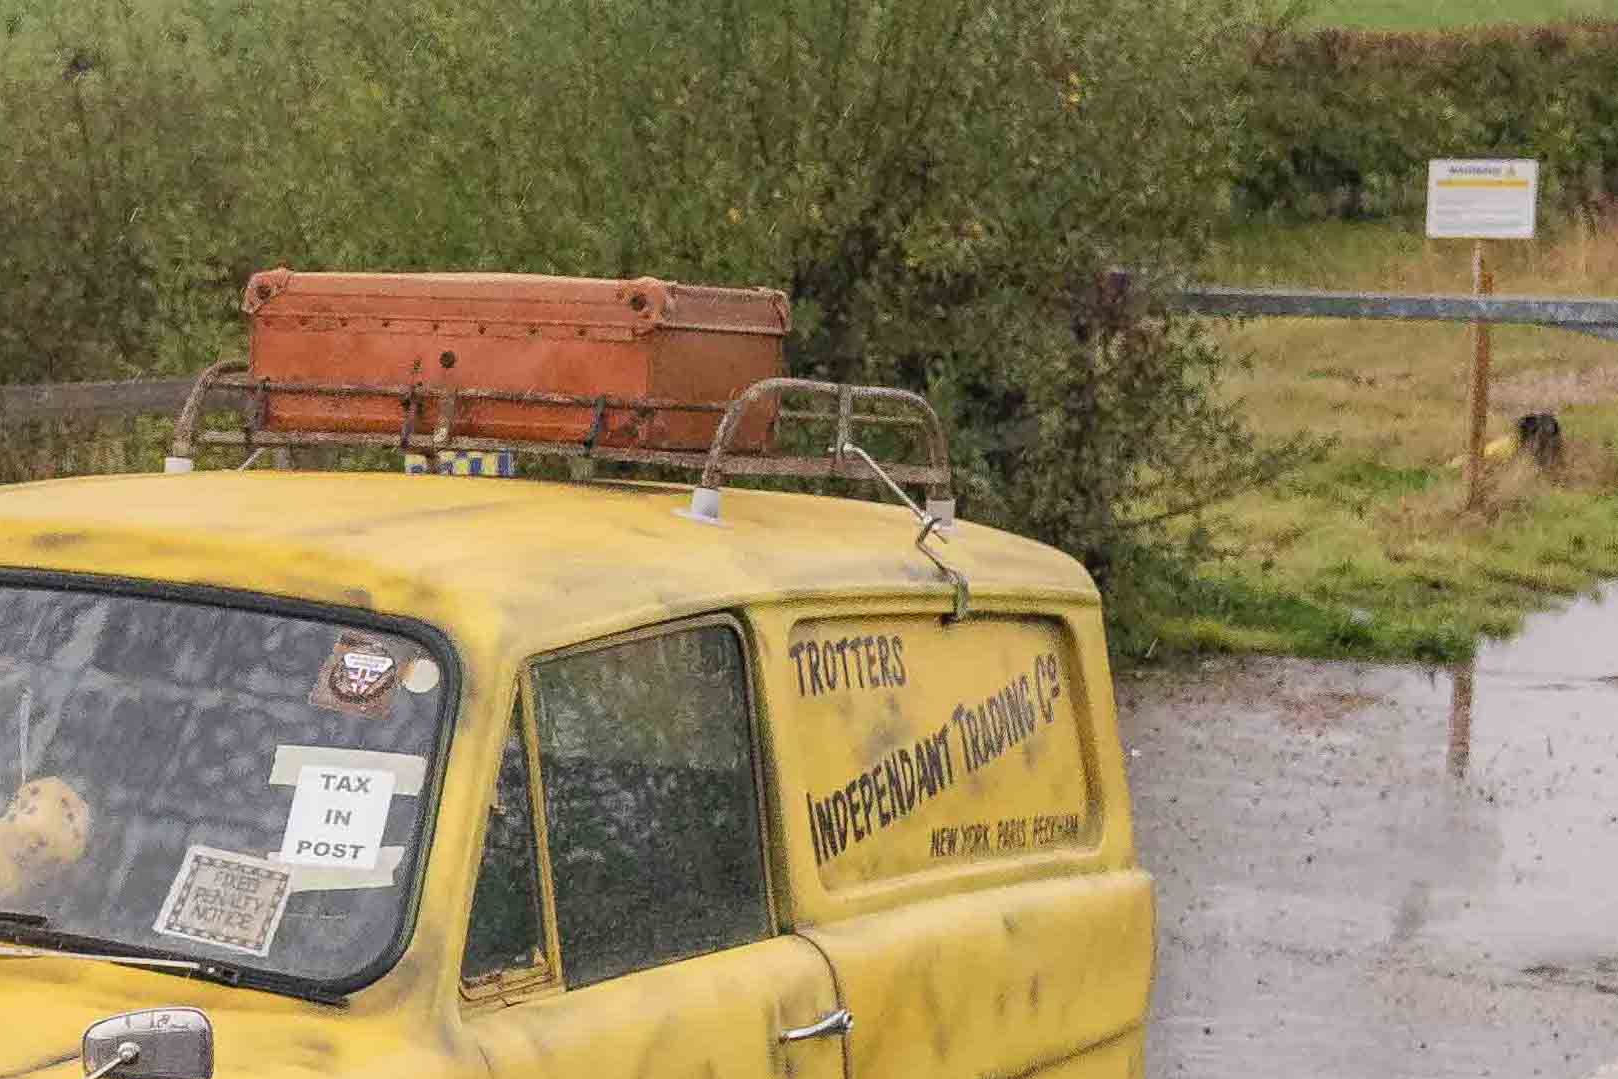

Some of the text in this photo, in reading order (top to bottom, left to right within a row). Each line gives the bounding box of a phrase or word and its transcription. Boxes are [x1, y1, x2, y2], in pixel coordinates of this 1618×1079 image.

[790, 634, 907, 697] TROTTERS
[806, 723, 953, 867] INDEPENDANT
[952, 674, 1035, 773] TRADING
[320, 773, 372, 793] TAX
[324, 808, 353, 827] IN
[295, 840, 367, 860] POST
[930, 826, 958, 857] NEW
[959, 822, 991, 856] YORK
[194, 886, 262, 911] PENALTY
[192, 904, 258, 928] NOTICE
